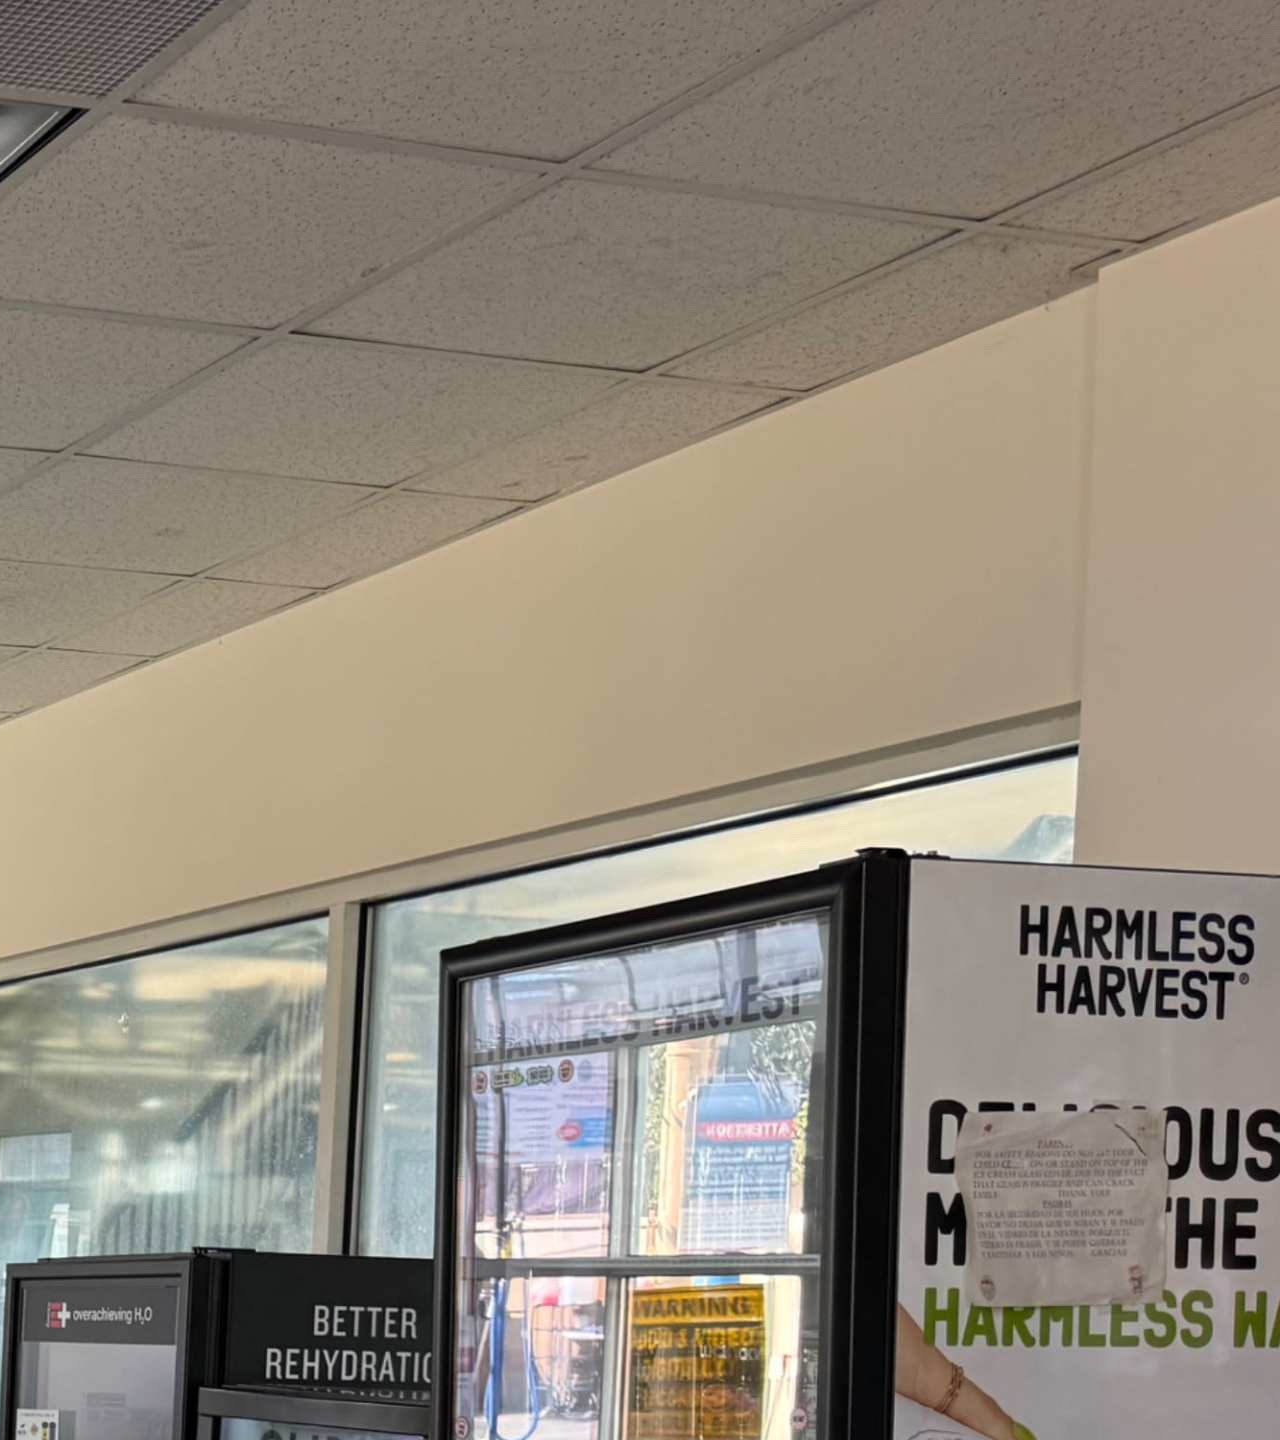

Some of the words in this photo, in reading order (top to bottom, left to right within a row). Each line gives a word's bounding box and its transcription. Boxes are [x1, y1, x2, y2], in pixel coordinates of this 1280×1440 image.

[1019, 904, 1256, 966] HARMLESS
[1036, 963, 1237, 1021] HARVEST
[1165, 1196, 1258, 1269] HE
[73, 1308, 132, 1324] overachieving
[313, 1305, 417, 1339] BETTER
[923, 1287, 1213, 1348] HARMLESS
